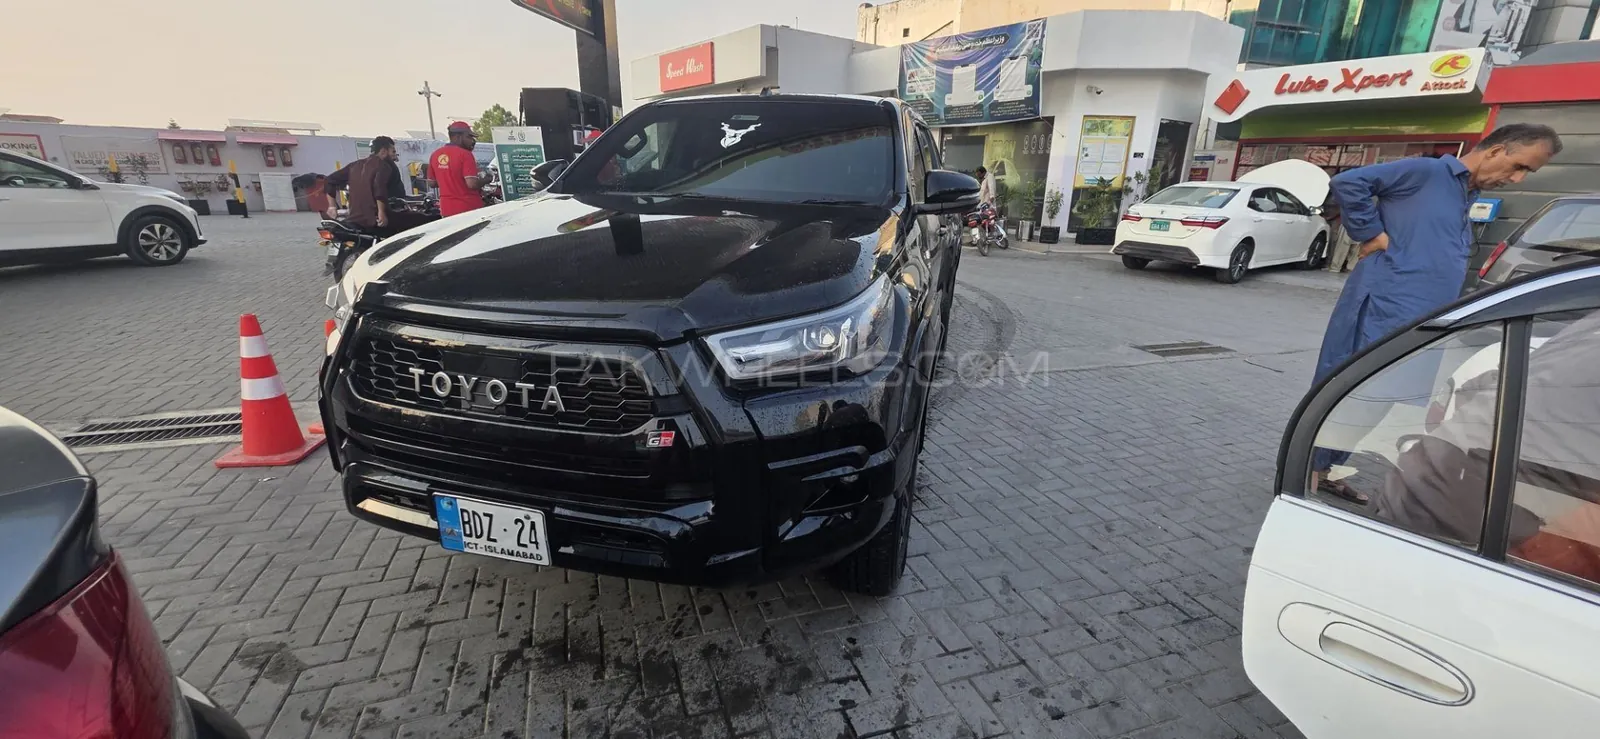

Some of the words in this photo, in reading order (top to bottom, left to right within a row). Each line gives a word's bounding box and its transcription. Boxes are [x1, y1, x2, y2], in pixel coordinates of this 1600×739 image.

[666, 62, 684, 79] Speed
[685, 58, 704, 74] Wash
[1274, 73, 1329, 96] Lube
[1332, 67, 1414, 93] Xpert
[1420, 77, 1468, 92] Attock
[0, 142, 37, 150] OKING
[409, 367, 565, 412] TOYOTA
[648, 436, 673, 447] GR
[460, 507, 498, 543] BDZ
[514, 518, 540, 550] 24
[463, 541, 543, 562] ICT-ISLAMABAD
